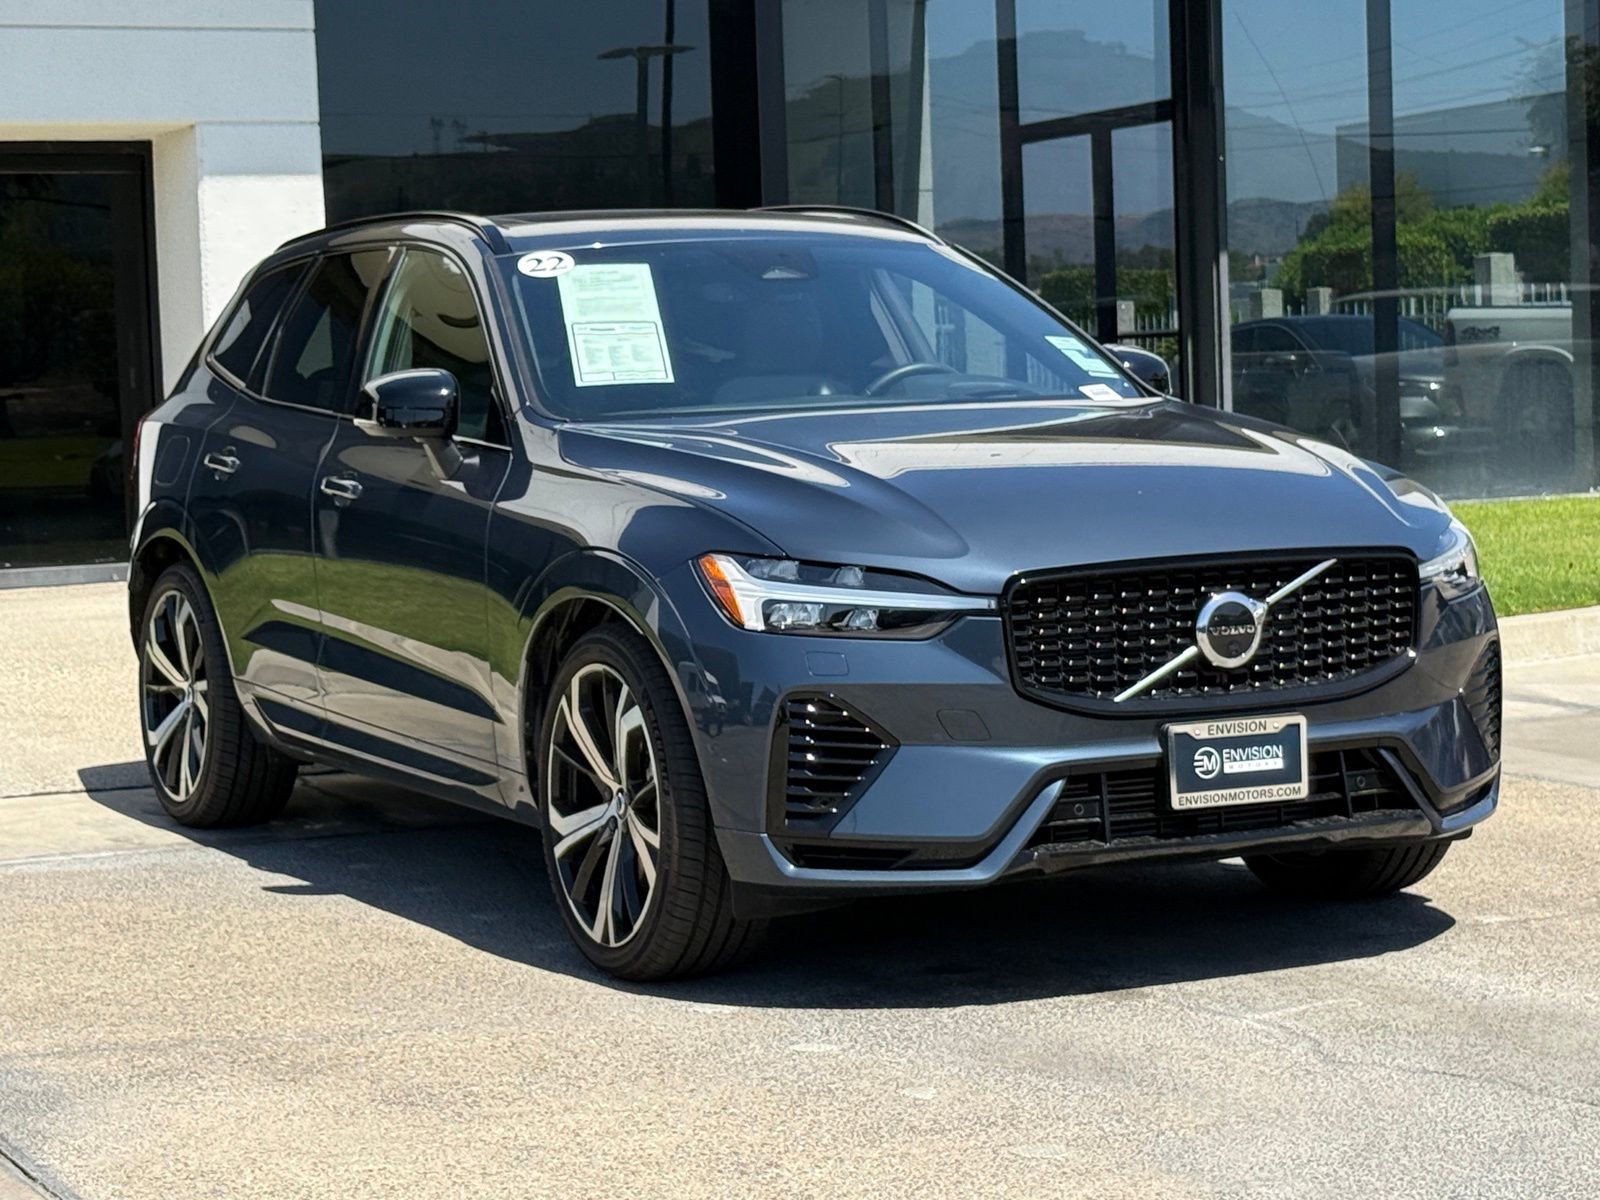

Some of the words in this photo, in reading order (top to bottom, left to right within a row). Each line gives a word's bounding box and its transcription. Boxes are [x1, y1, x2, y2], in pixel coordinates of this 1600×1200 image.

[526, 256, 568, 272] 22
[1209, 624, 1255, 636] VOLVO
[1207, 720, 1267, 736] ENVISION
[1222, 744, 1283, 763] ENVISION
[1178, 786, 1301, 807] ENVISIONMOTORS.COM
